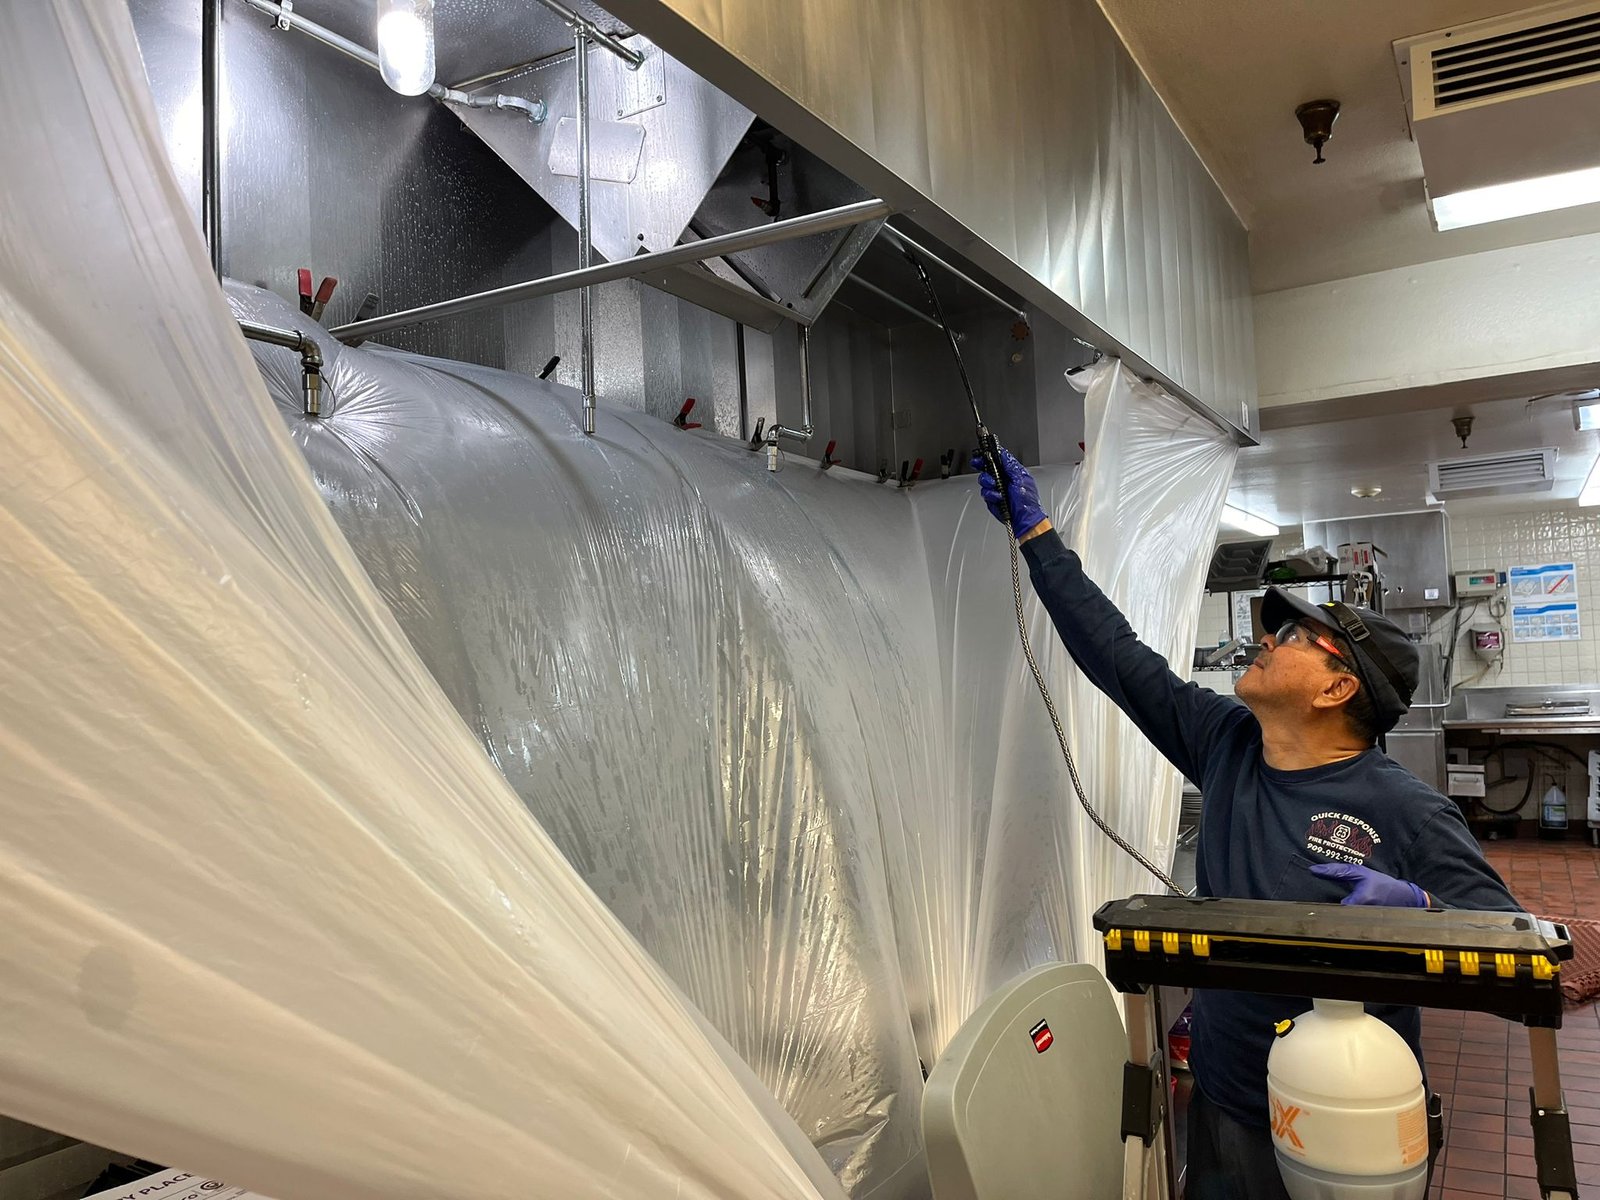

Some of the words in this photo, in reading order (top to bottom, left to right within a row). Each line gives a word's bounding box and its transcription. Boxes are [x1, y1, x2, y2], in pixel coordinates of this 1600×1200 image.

[1310, 812, 1341, 822] QUICK
[1341, 814, 1382, 844] RESPONSE
[1308, 835, 1323, 844] FIRE
[1322, 839, 1366, 857] PROTECTION
